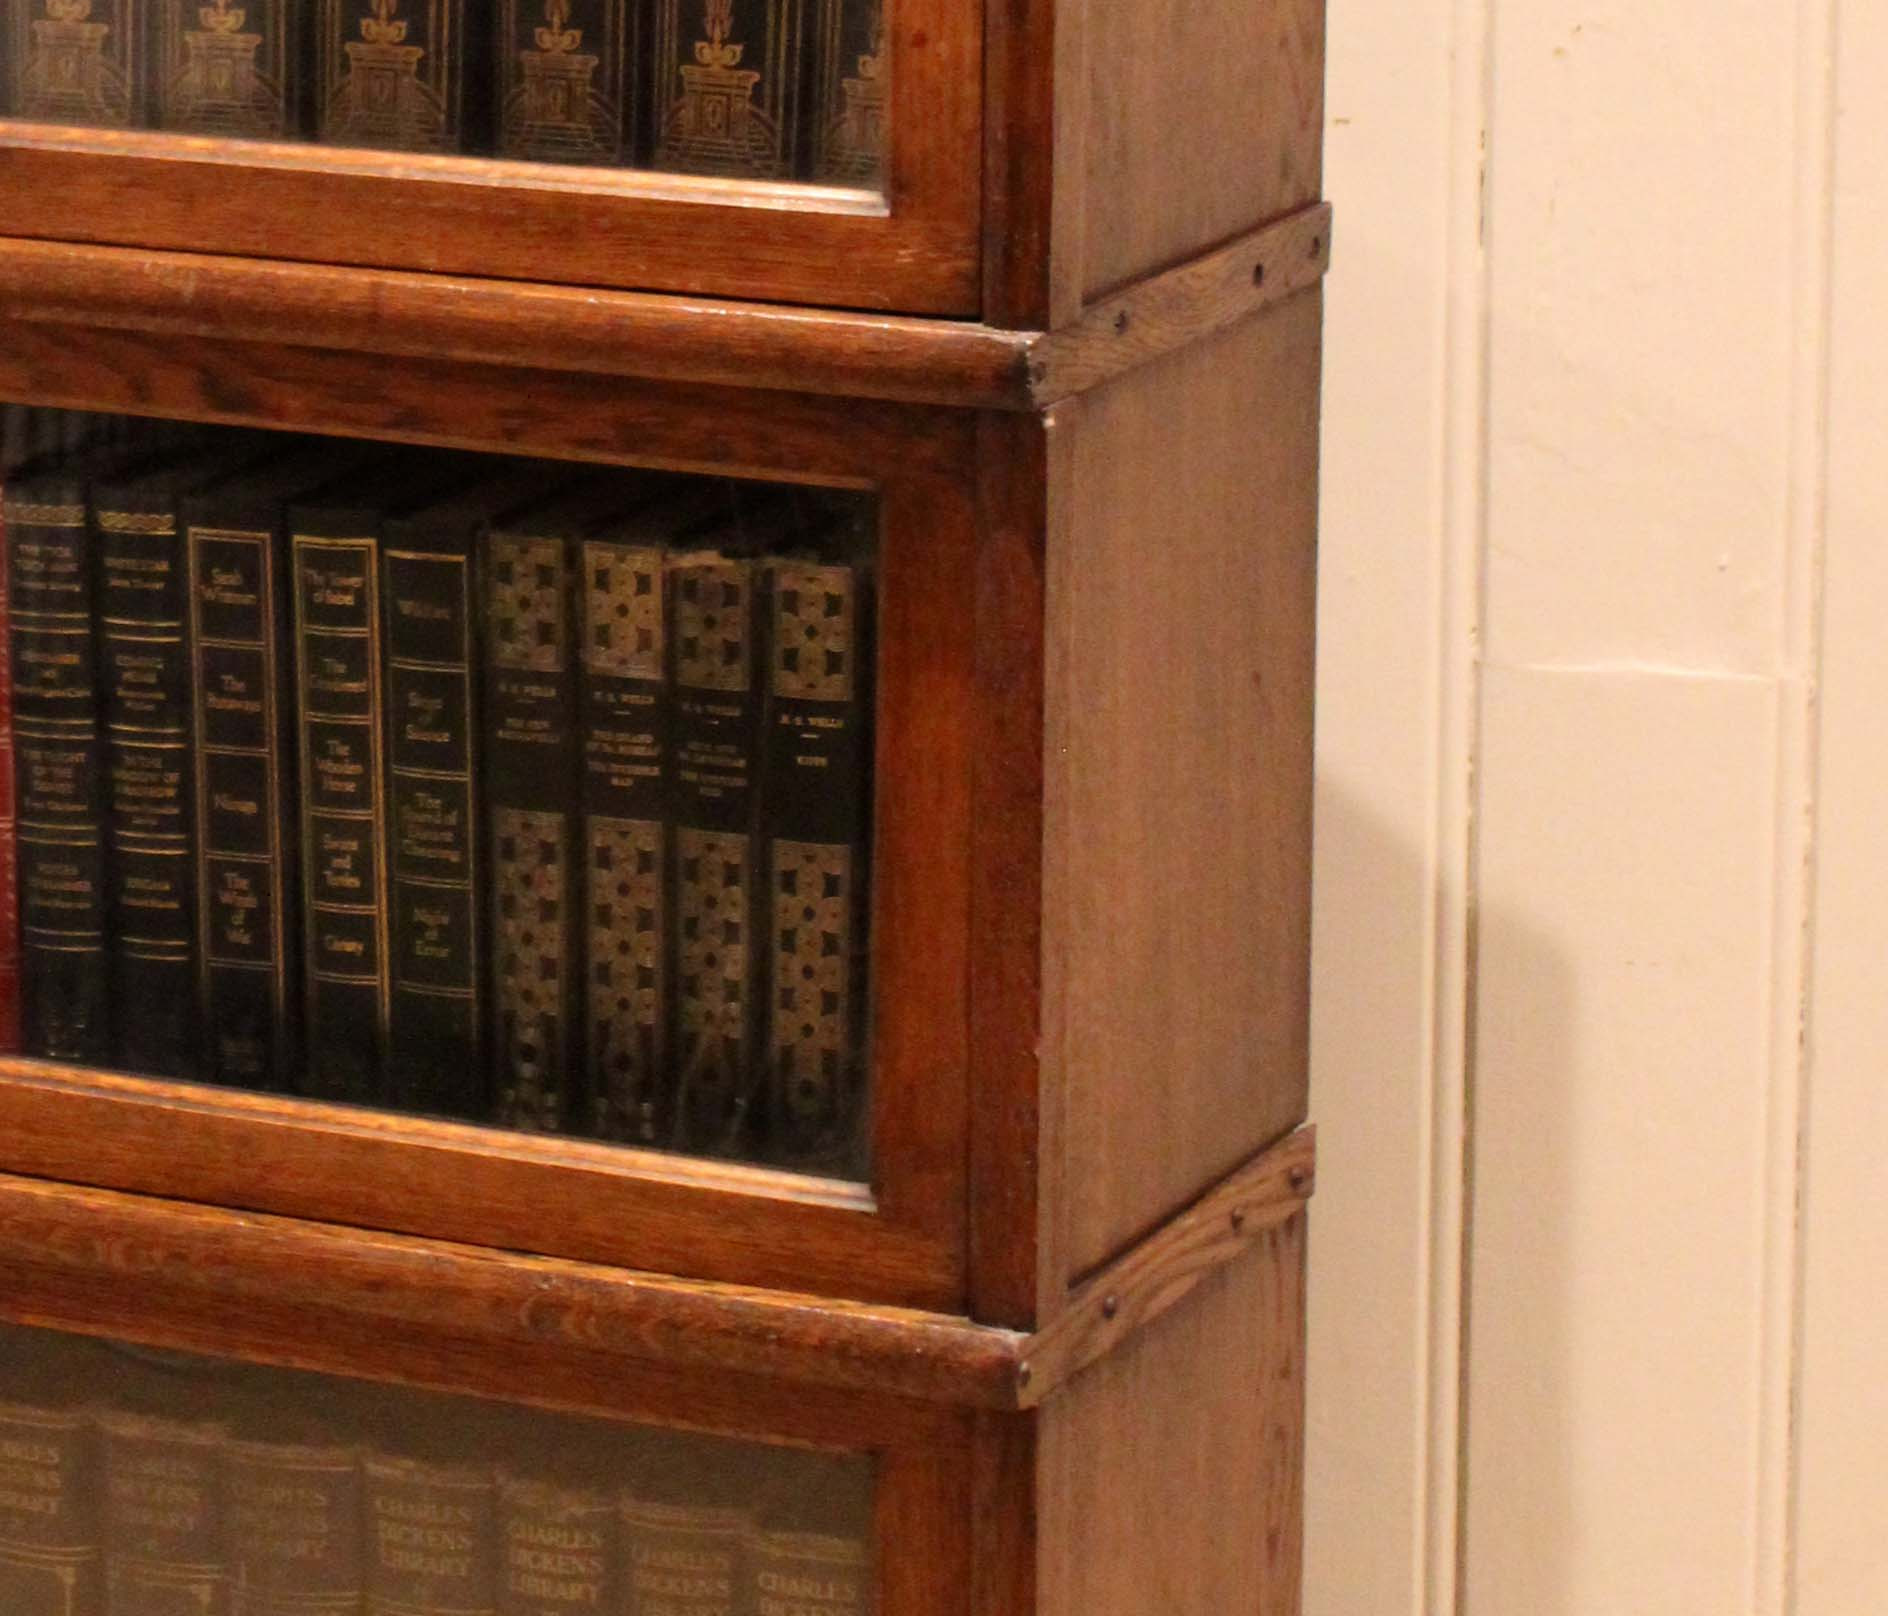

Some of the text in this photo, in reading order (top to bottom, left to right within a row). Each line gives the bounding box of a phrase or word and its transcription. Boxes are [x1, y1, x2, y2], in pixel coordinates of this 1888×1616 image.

[374, 1496, 473, 1523] CHARLES
[376, 1519, 473, 1551] DICKENS
[506, 1520, 603, 1550] CHARLES
[379, 1544, 471, 1577] LIBRARY
[507, 1545, 605, 1575] DICKENS
[508, 1570, 600, 1602] LIBRARY
[632, 1568, 730, 1599] DICKENS
[757, 1571, 858, 1602] CHARLES
